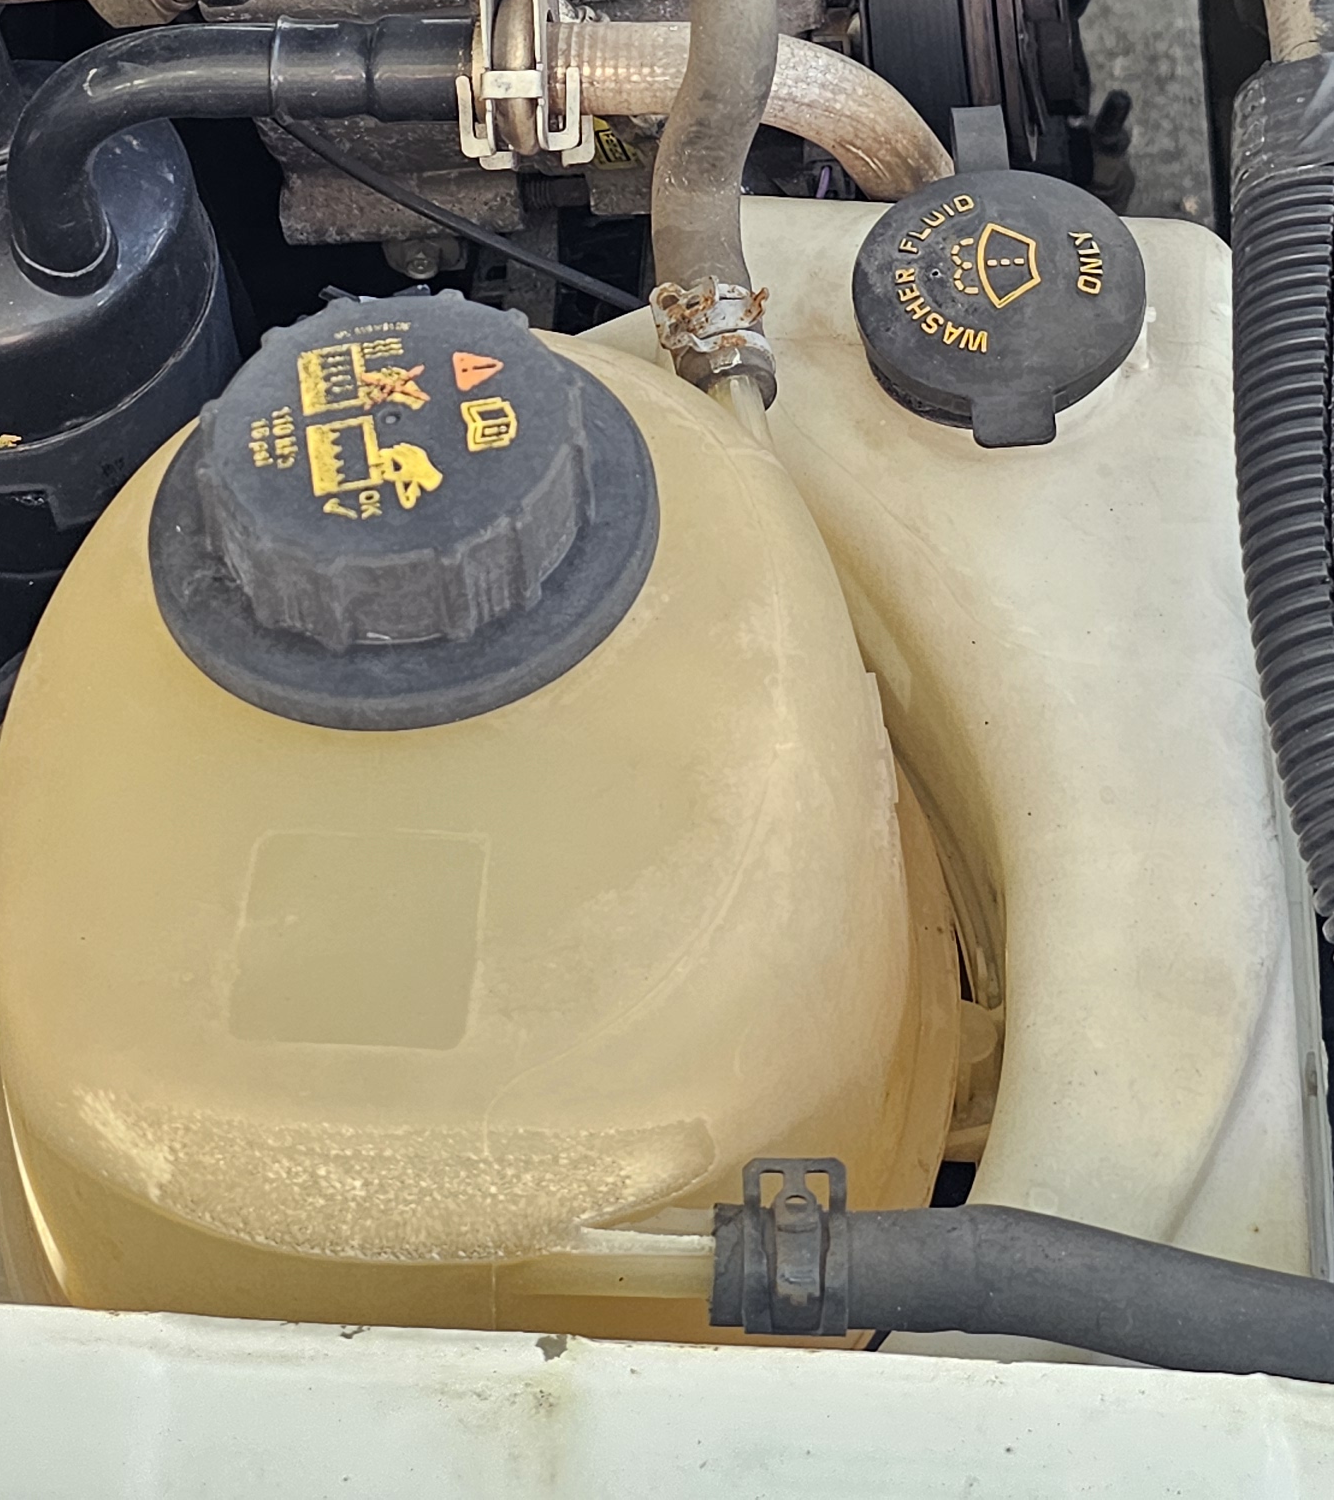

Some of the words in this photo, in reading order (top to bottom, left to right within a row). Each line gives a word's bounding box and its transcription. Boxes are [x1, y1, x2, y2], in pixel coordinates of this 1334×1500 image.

[898, 193, 975, 253] FLUID
[1067, 230, 1103, 295] ONLY
[894, 267, 988, 353] WASHER
[358, 490, 382, 519] OK
